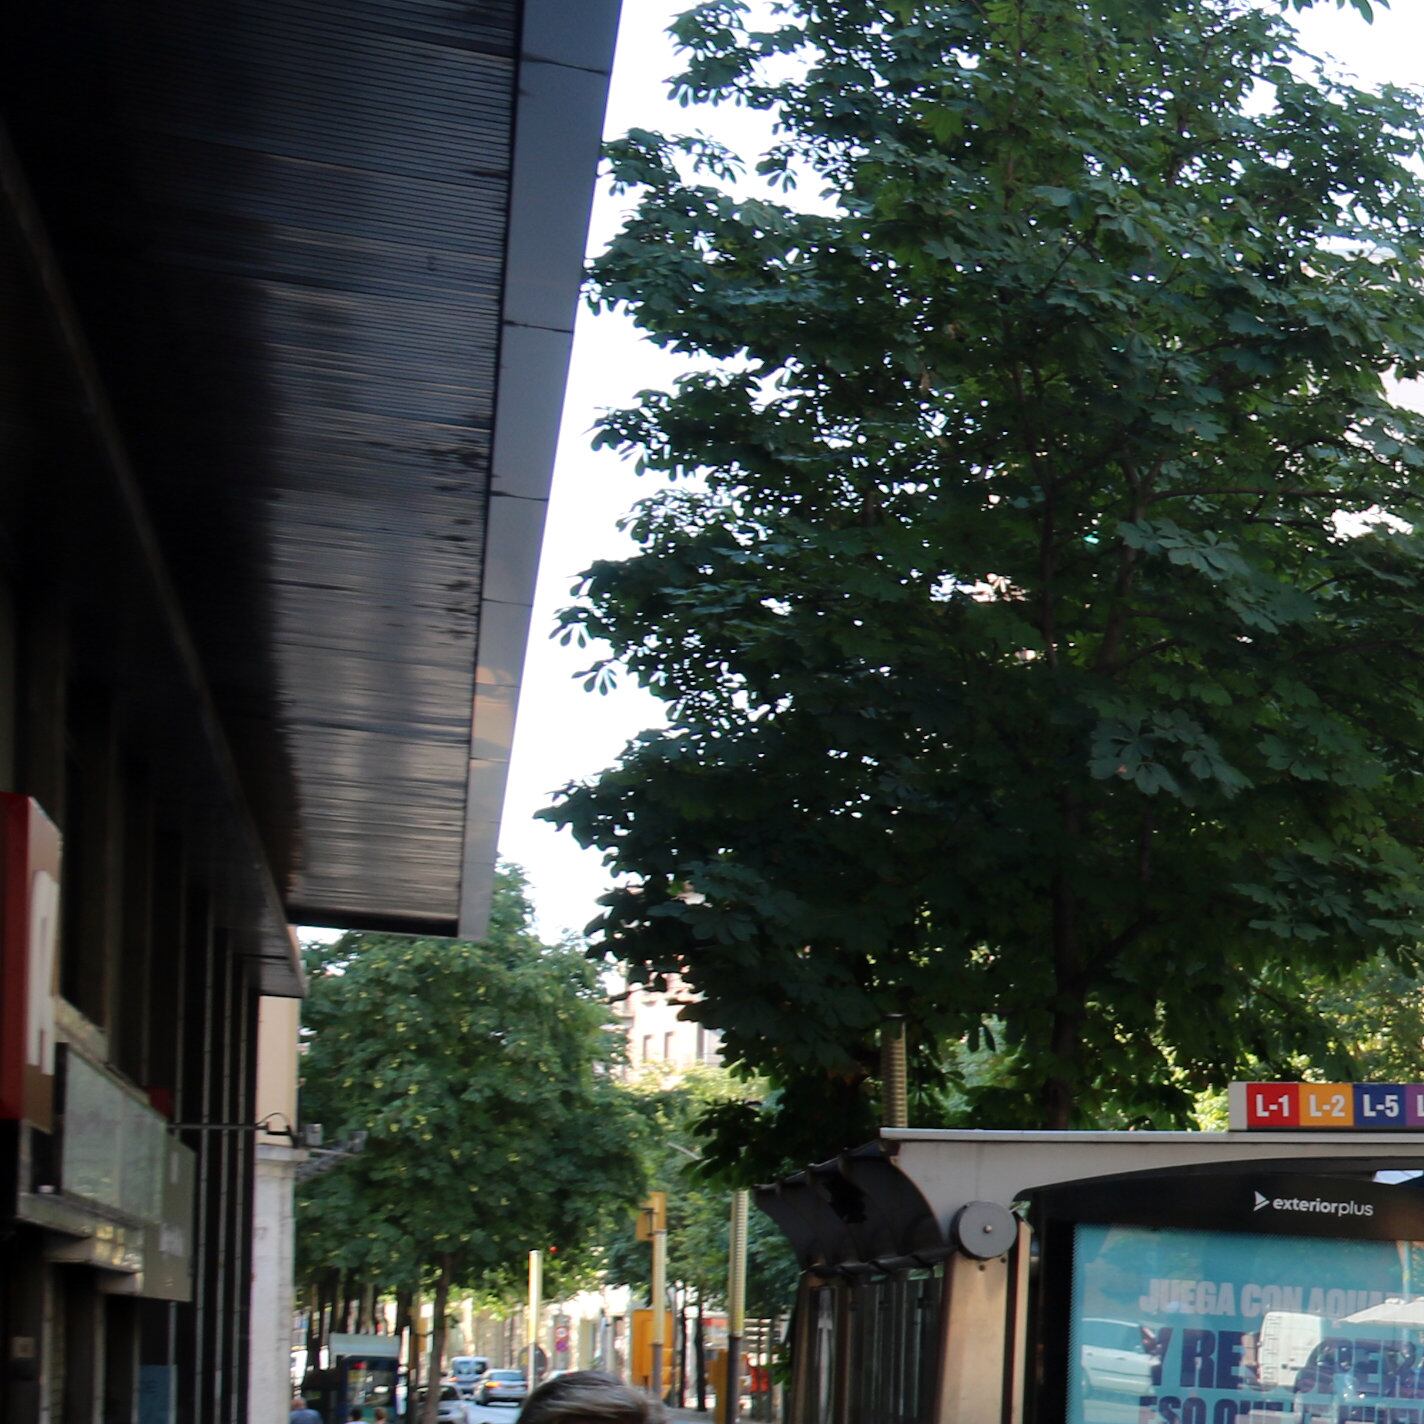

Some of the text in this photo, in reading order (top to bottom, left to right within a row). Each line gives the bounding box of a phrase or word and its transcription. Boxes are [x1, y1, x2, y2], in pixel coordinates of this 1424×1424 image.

[1255, 1093, 1290, 1117] L-1
[1308, 1093, 1346, 1117] L-2
[1362, 1093, 1399, 1118] L-5
[1272, 1196, 1375, 1217] exteriorplus
[1139, 1278, 1236, 1318] JUEGA
[1240, 1283, 1301, 1319] CON
